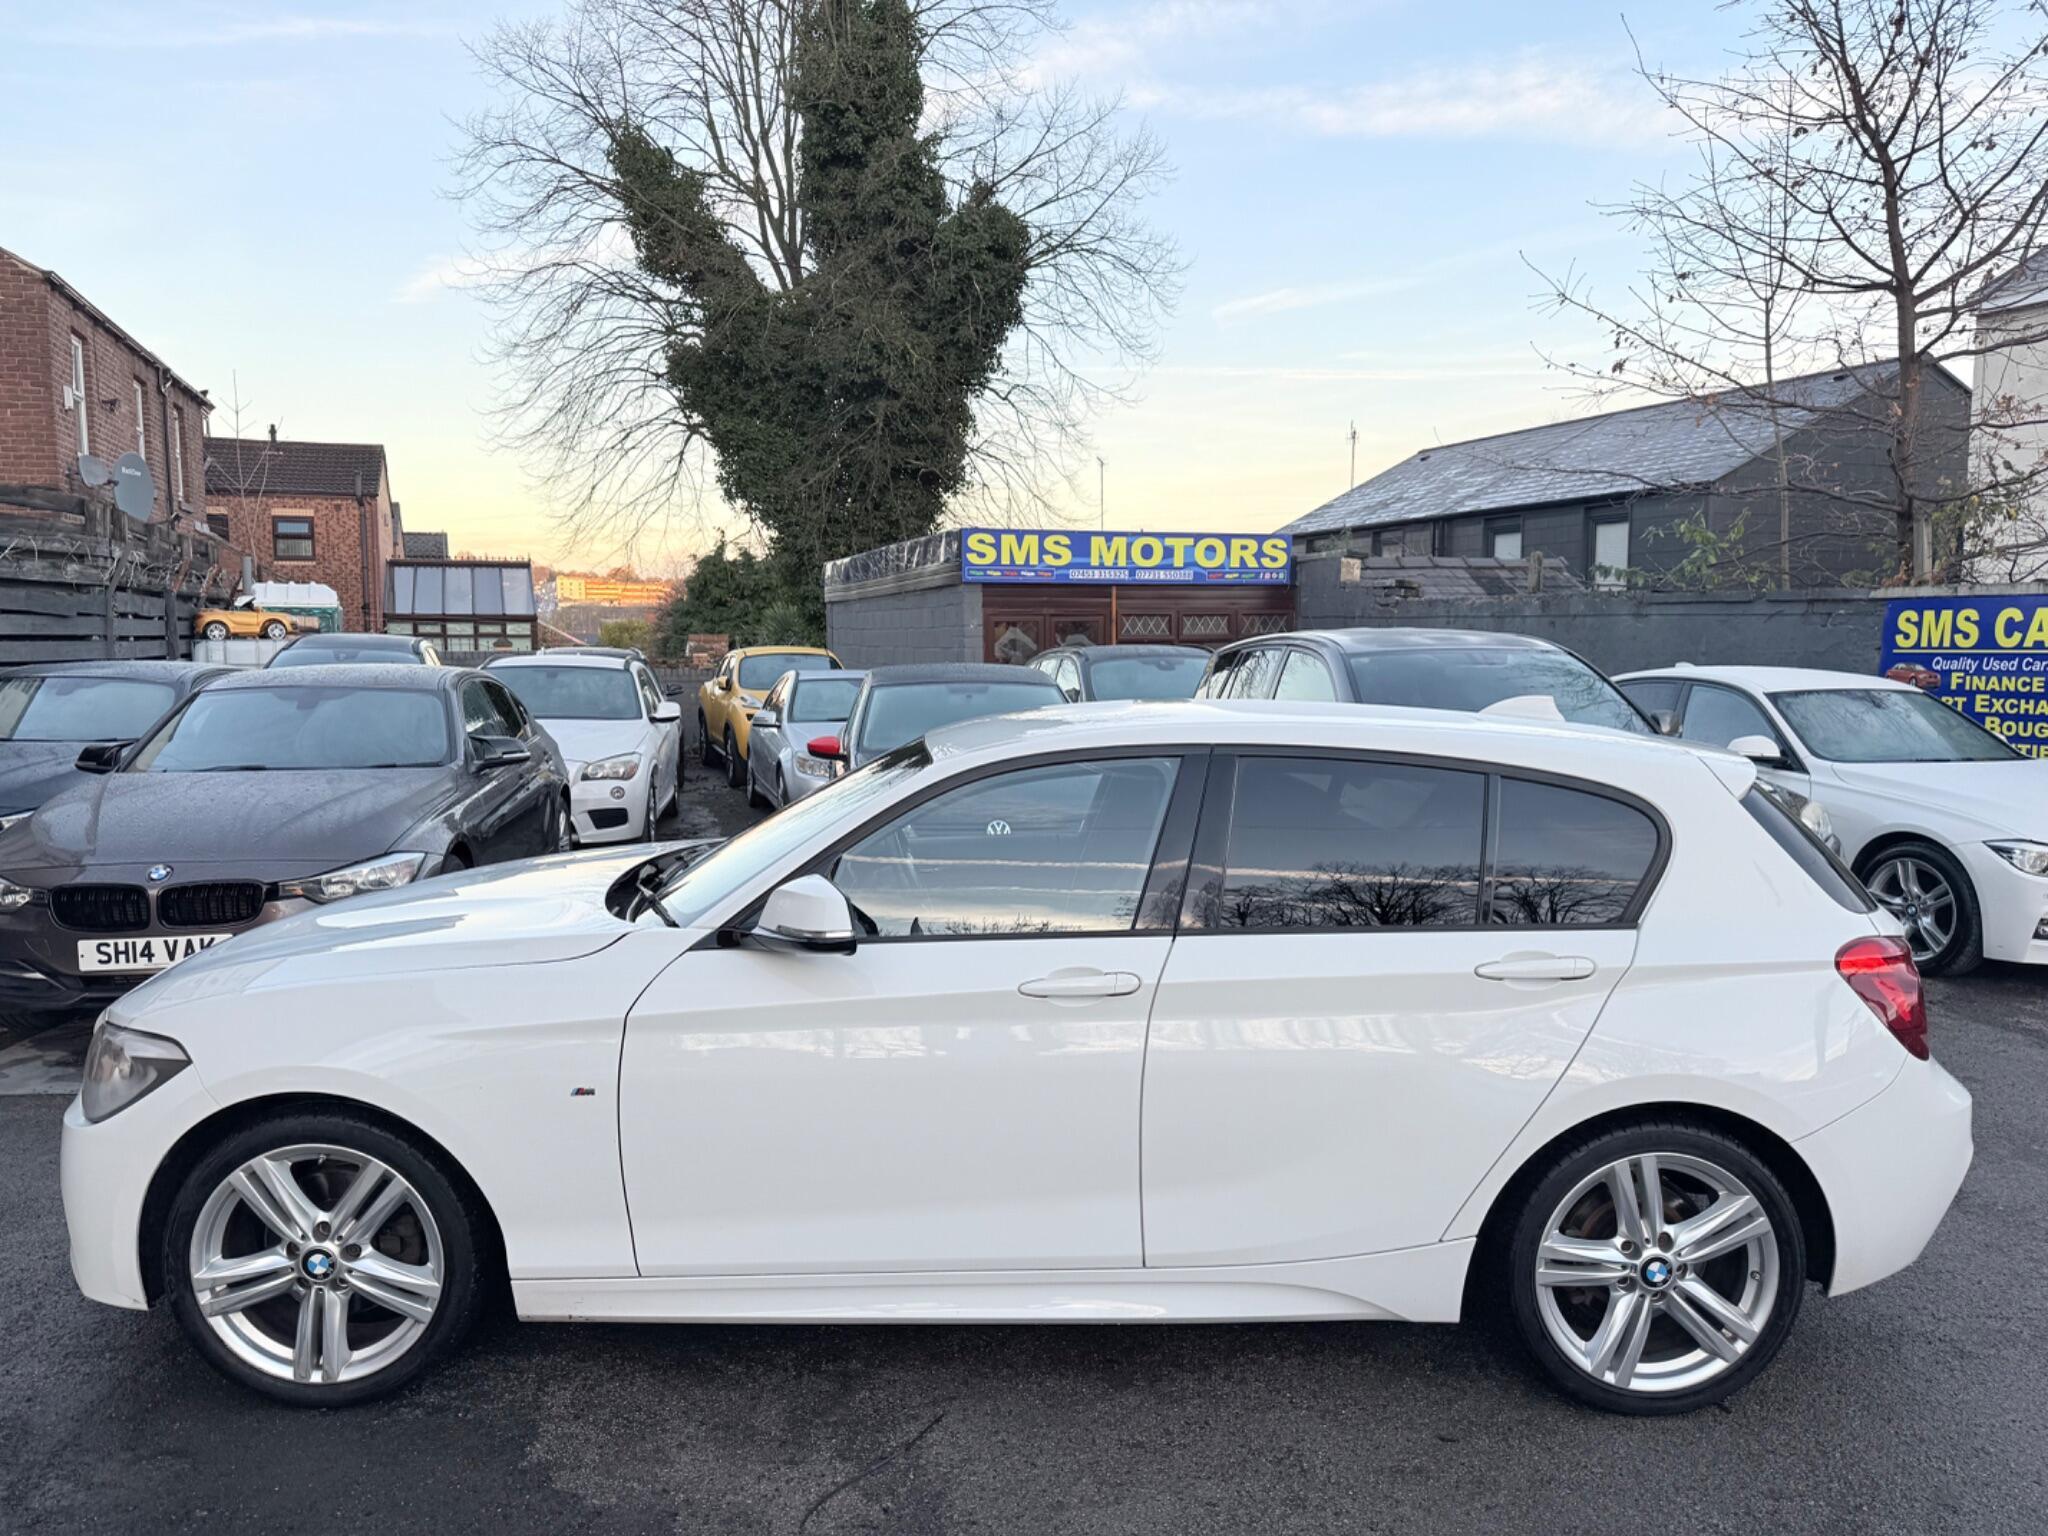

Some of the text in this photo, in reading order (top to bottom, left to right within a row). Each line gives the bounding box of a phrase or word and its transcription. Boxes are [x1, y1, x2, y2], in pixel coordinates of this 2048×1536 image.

[966, 532, 1288, 569] SMS MOTORS
[1895, 607, 2048, 648] SMS CA
[1932, 656, 2048, 674] Quality Used Car
[1950, 672, 2046, 693] FINANCE
[96, 940, 156, 965] SH14
